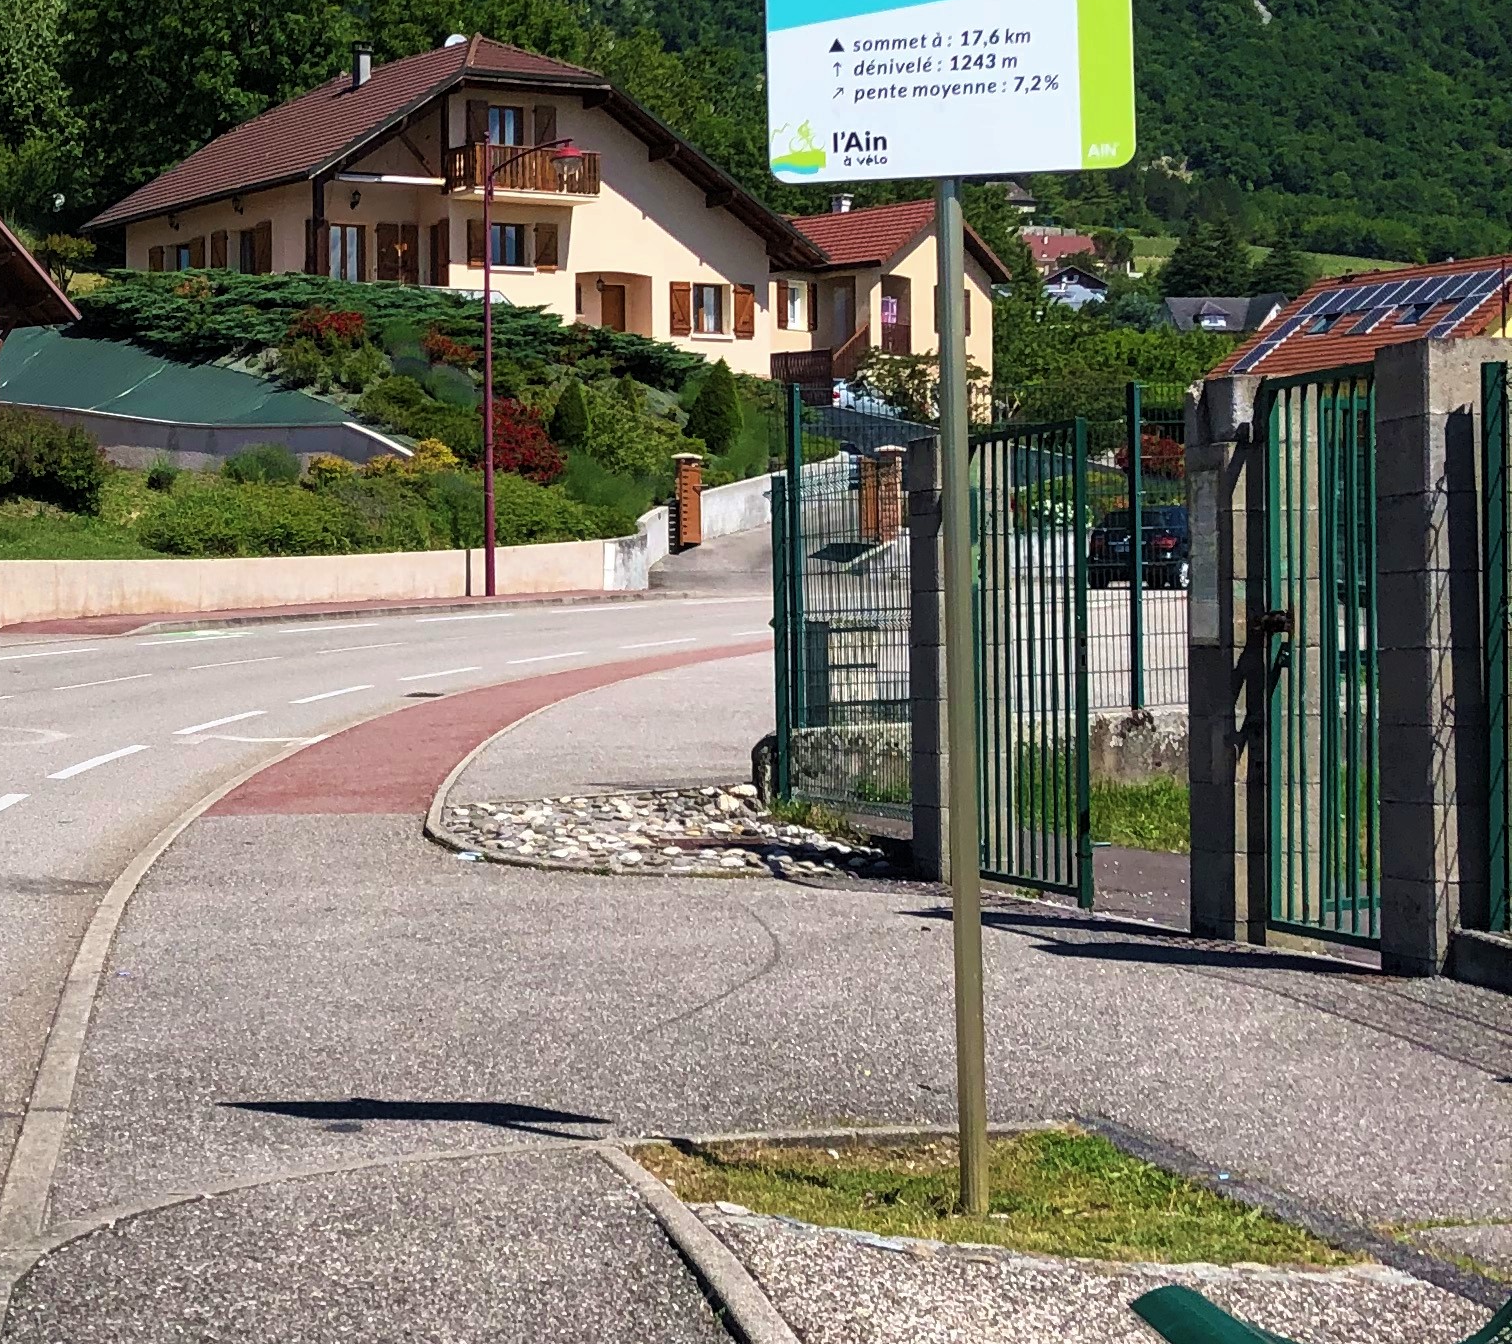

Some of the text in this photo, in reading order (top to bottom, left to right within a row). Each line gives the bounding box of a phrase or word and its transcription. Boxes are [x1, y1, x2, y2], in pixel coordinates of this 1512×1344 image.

[853, 34, 927, 53] sommet
[960, 28, 1000, 48] 17,6
[1005, 28, 1031, 45] km
[853, 56, 932, 77] dénivelé
[950, 53, 996, 71] 1243
[1001, 56, 1018, 69] m
[854, 84, 907, 104] pente
[912, 81, 997, 99] moyenne
[1014, 74, 1059, 94] 7,2%
[833, 130, 887, 153] l'Ain
[843, 154, 888, 166] à vélo
